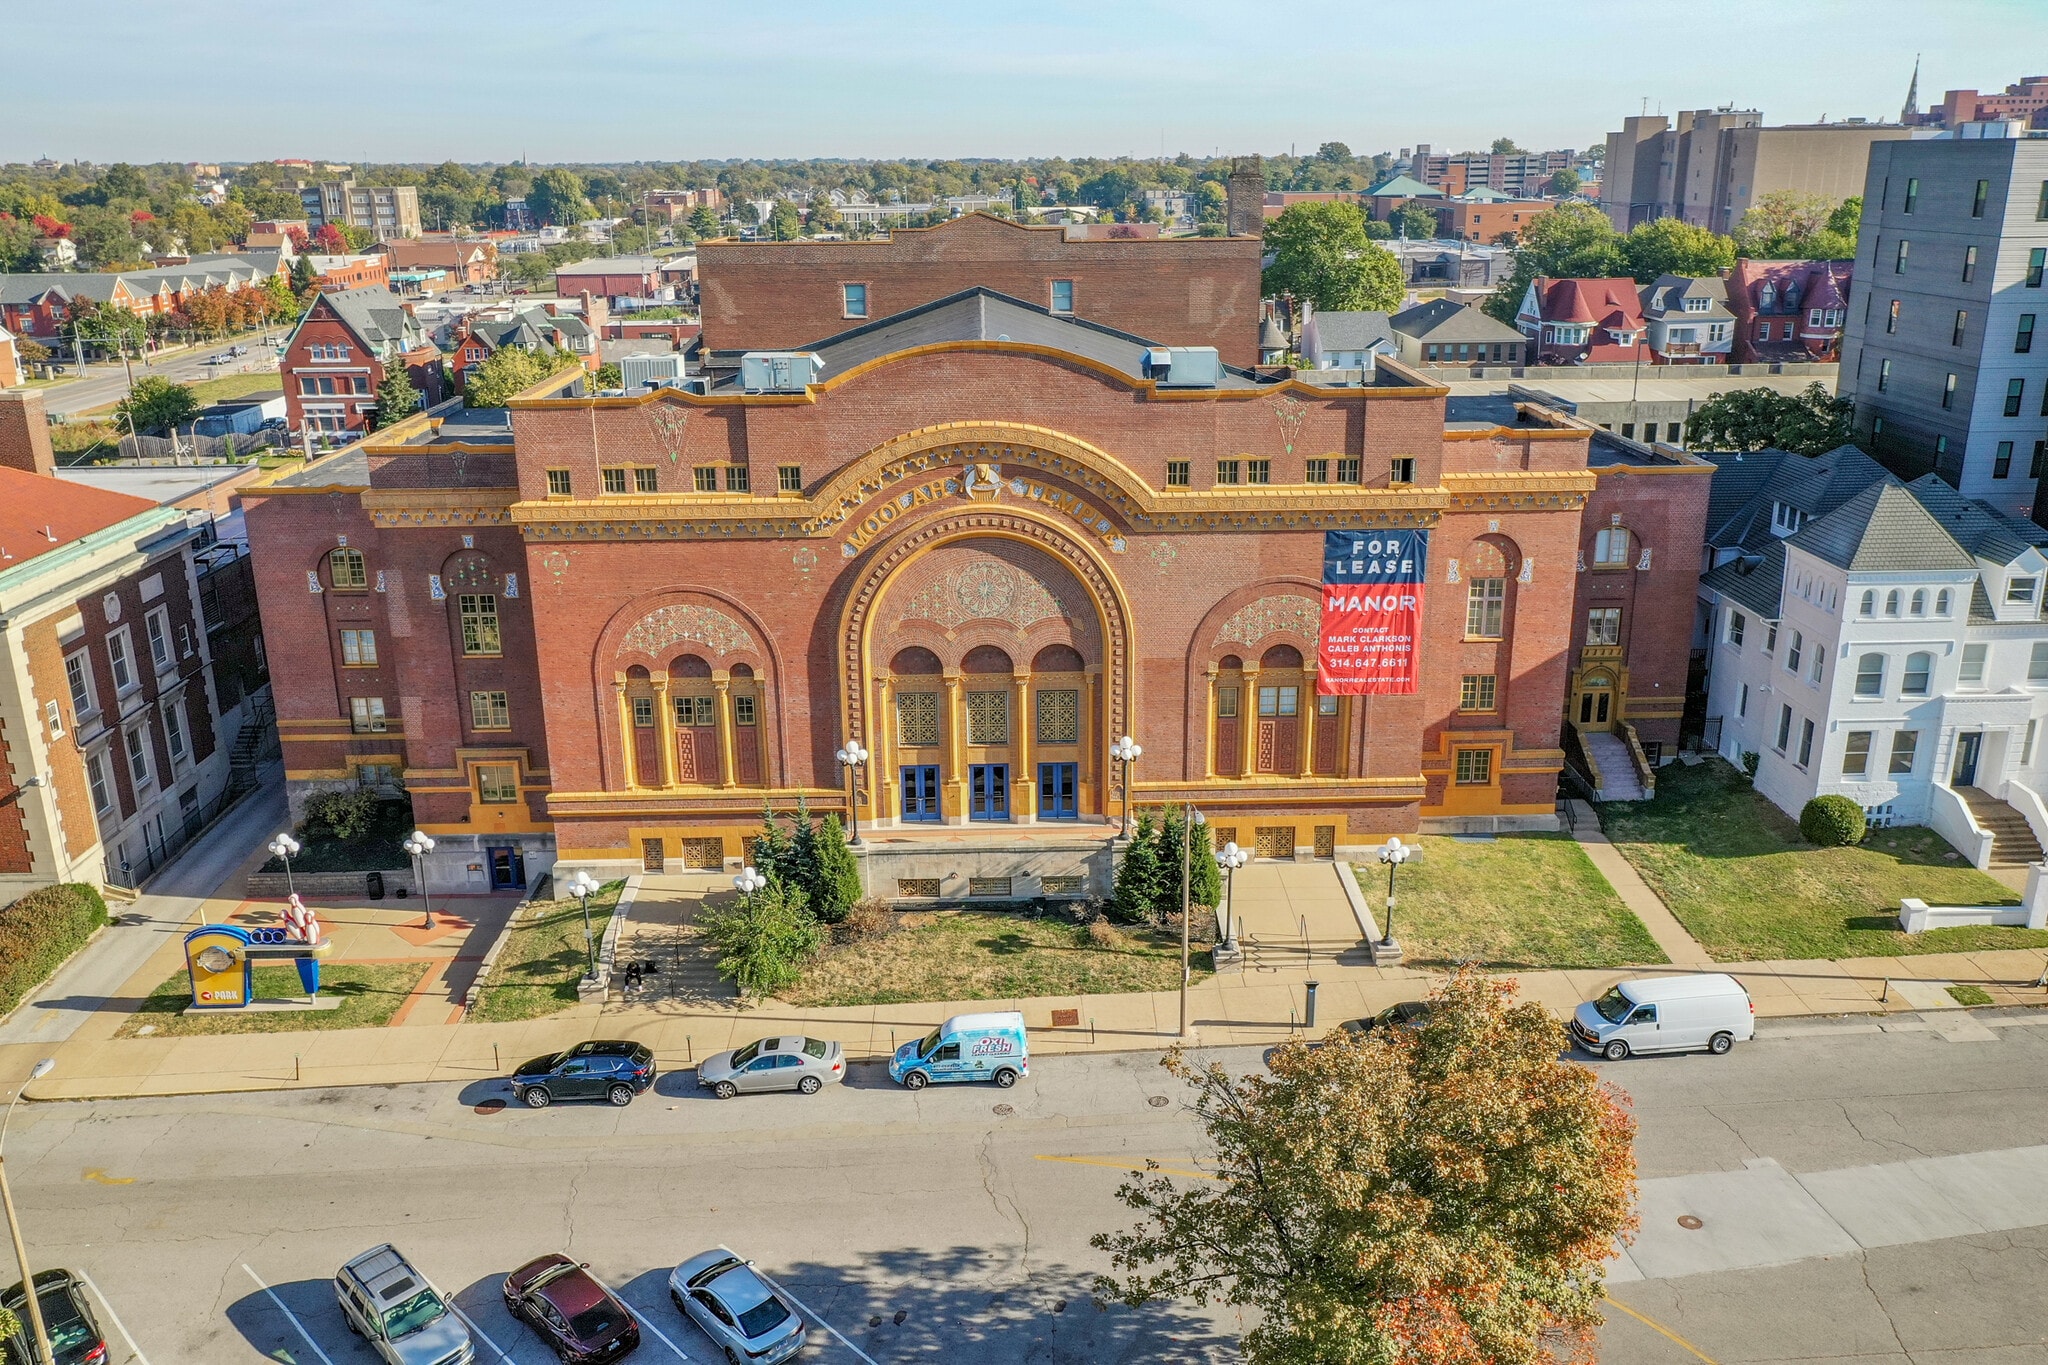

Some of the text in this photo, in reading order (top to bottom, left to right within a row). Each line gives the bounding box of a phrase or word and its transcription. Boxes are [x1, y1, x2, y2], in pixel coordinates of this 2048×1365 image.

[848, 479, 1122, 548] MOOLAH TEMPLE
[1352, 540, 1400, 555] FOR
[1336, 560, 1413, 574] LEASE
[1329, 595, 1416, 612] MANOR
[1328, 635, 1412, 643] MARK CLARKSON
[1327, 644, 1412, 653] CALEB ANTHONIS
[1330, 658, 1408, 668] 314.647.6611
[214, 990, 238, 1000] PARK
[979, 1037, 1005, 1046] OXI
[972, 1043, 1013, 1054] FRESH
